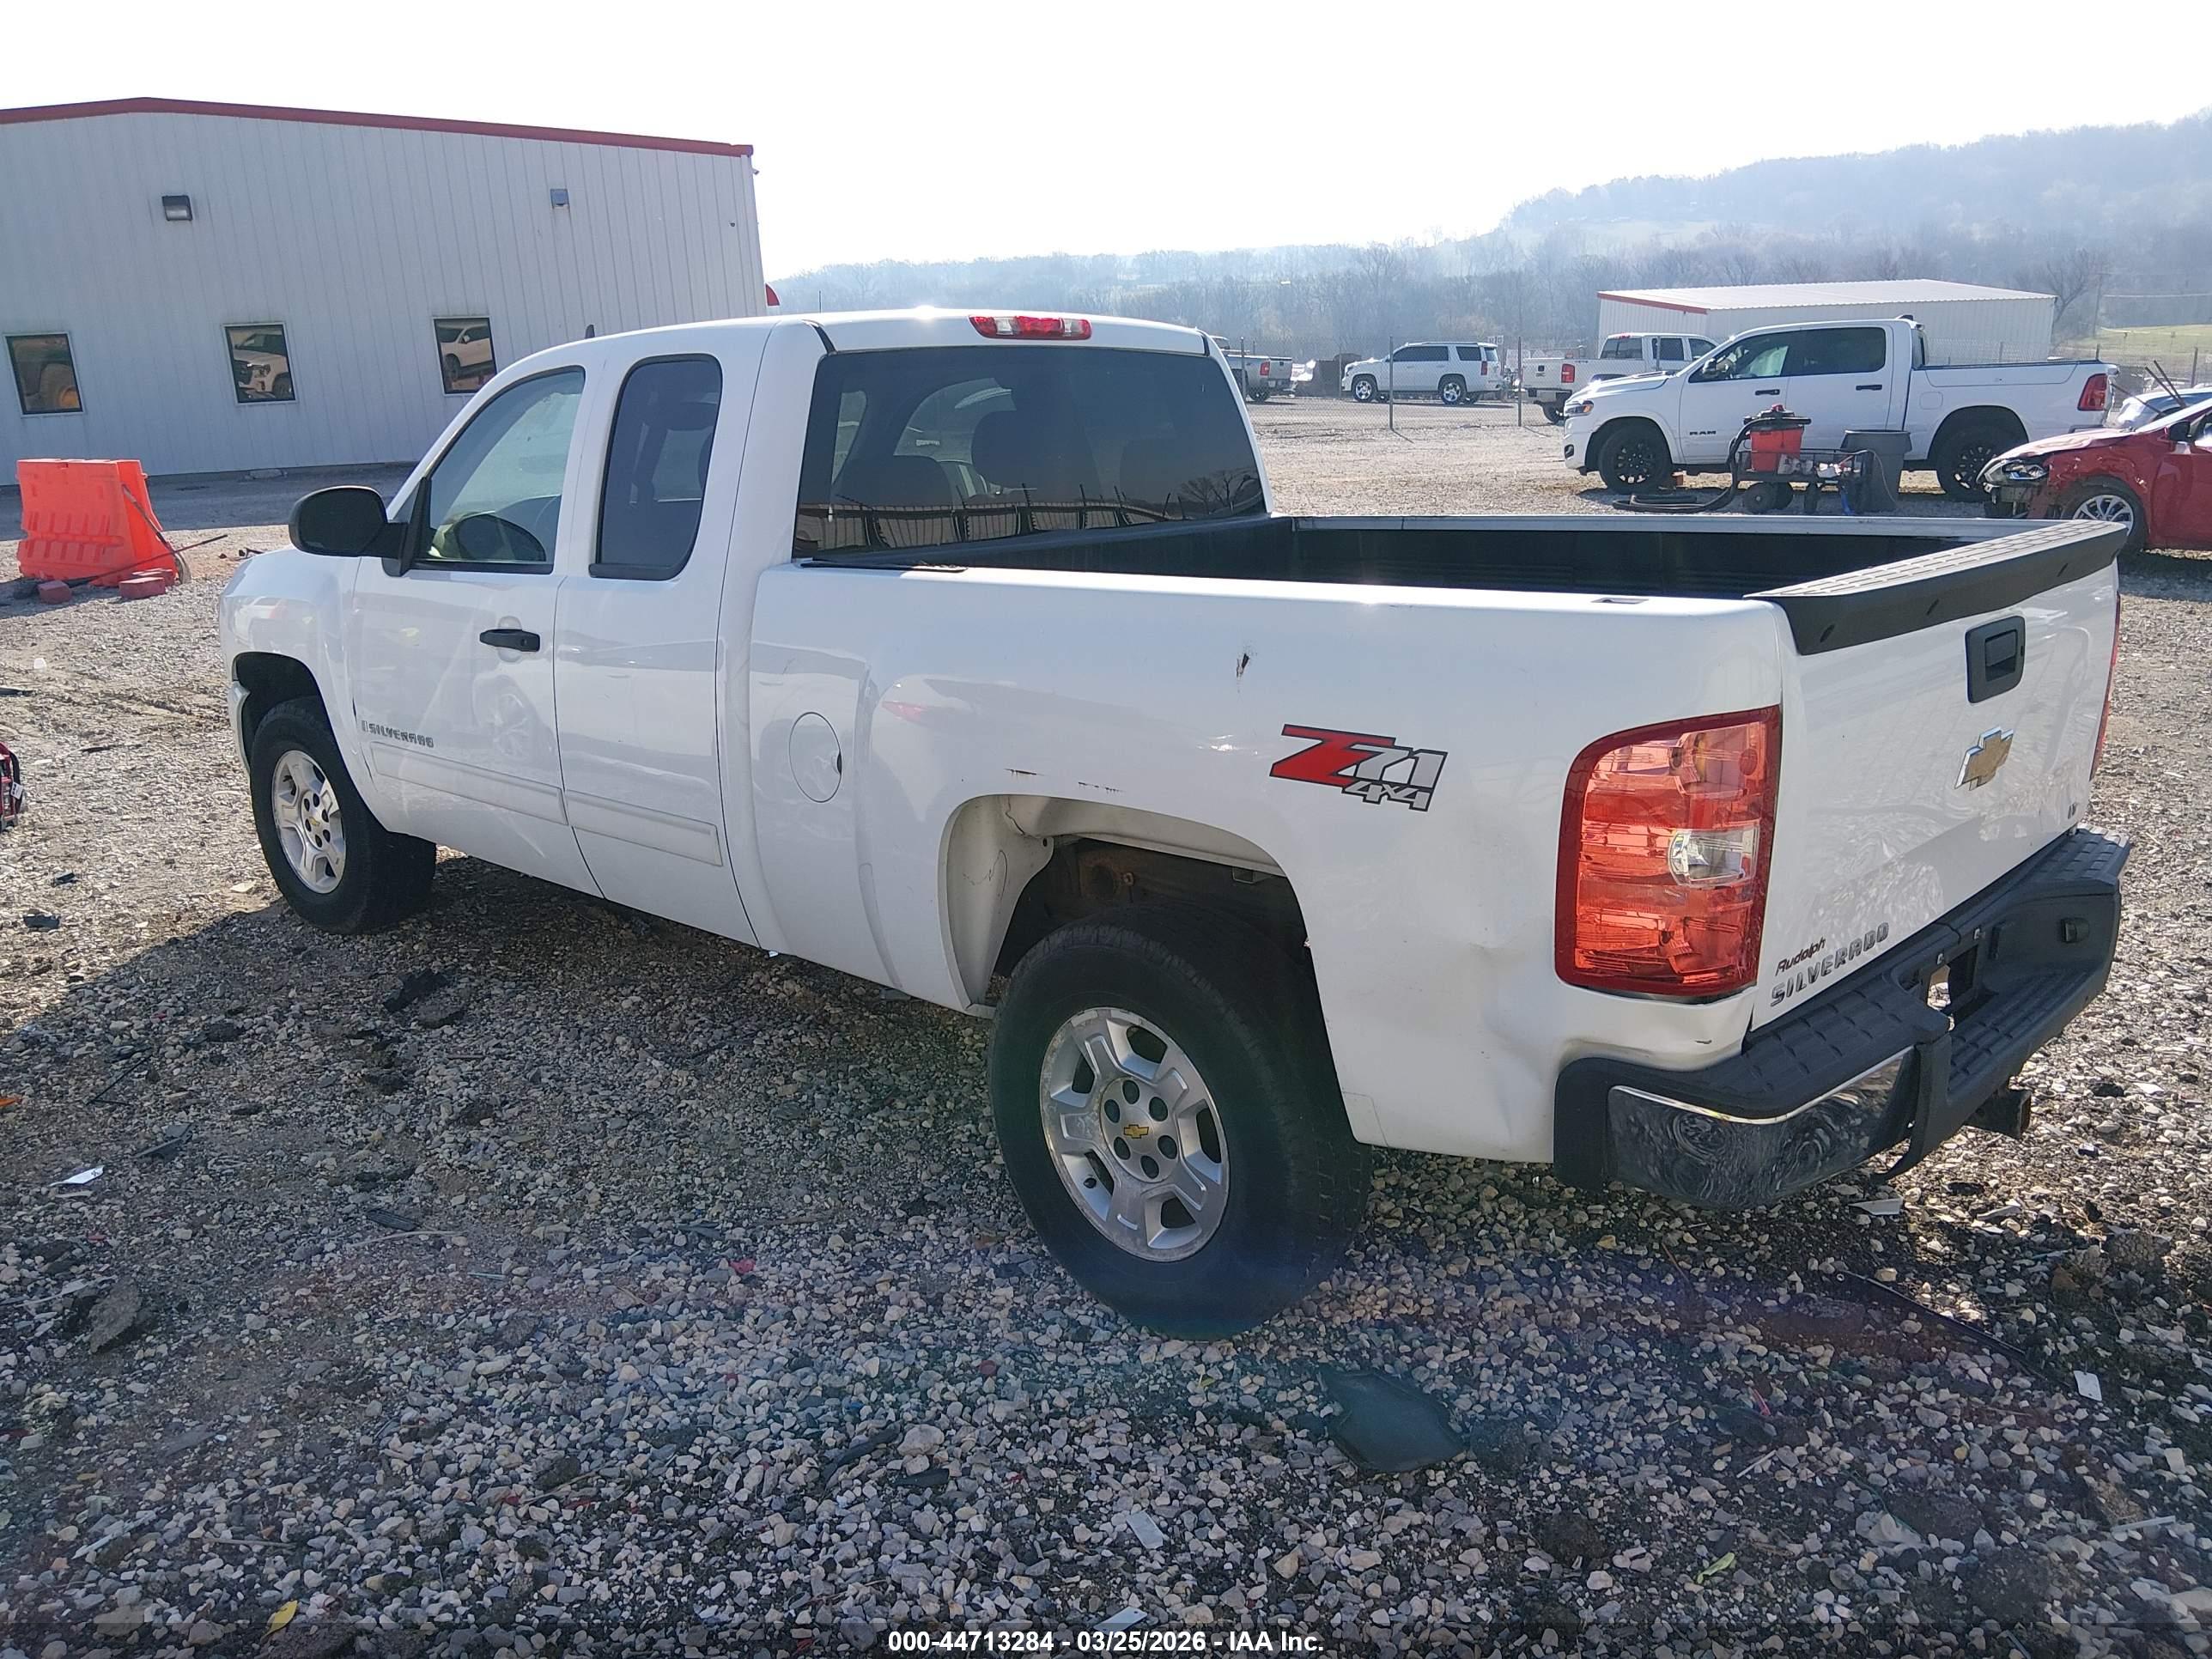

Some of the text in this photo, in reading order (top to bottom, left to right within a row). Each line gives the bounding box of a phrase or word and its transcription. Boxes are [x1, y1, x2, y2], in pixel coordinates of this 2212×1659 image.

[368, 723, 434, 748] SILVERADO
[1269, 724, 1449, 792] Z71
[1769, 921, 1890, 1007] SILVERADO
[1775, 936, 1827, 976] Rudolph
